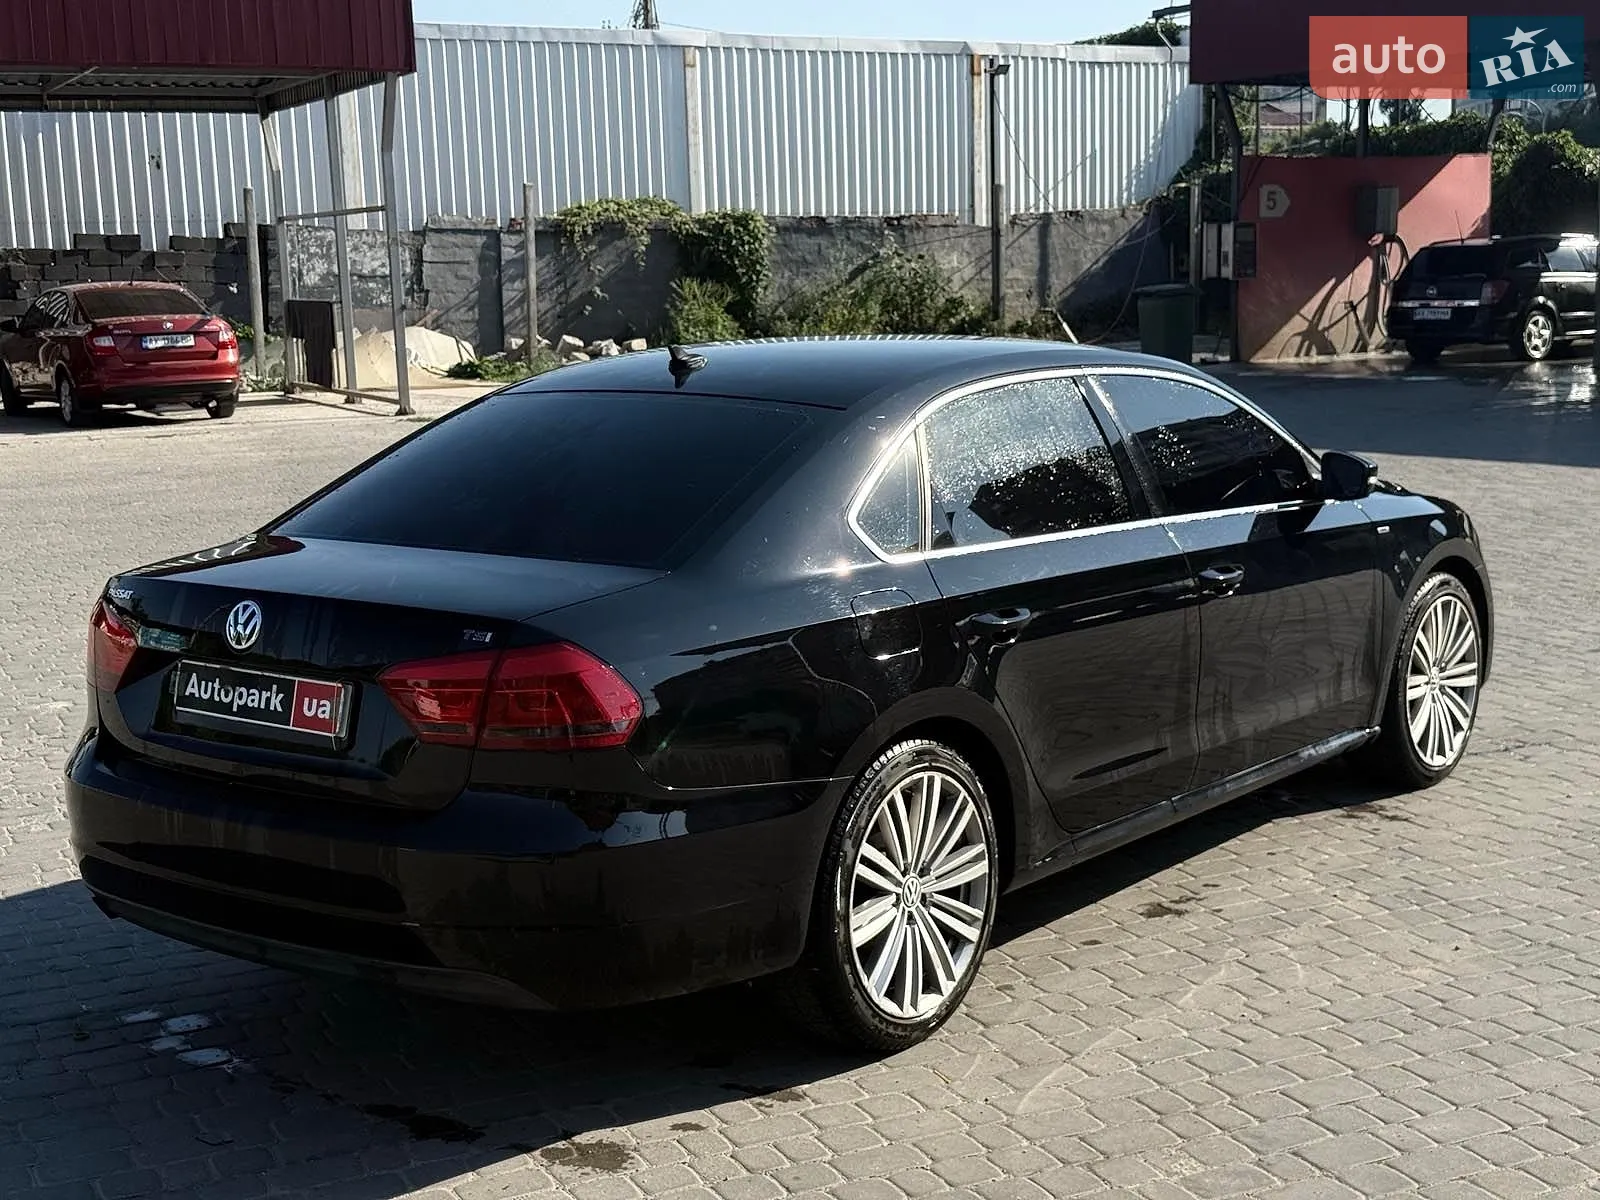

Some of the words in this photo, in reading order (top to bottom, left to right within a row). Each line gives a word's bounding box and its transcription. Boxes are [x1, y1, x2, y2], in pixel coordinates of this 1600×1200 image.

[1266, 191, 1277, 210] 5
[184, 672, 285, 712] Autopark
[303, 696, 331, 719] ua
